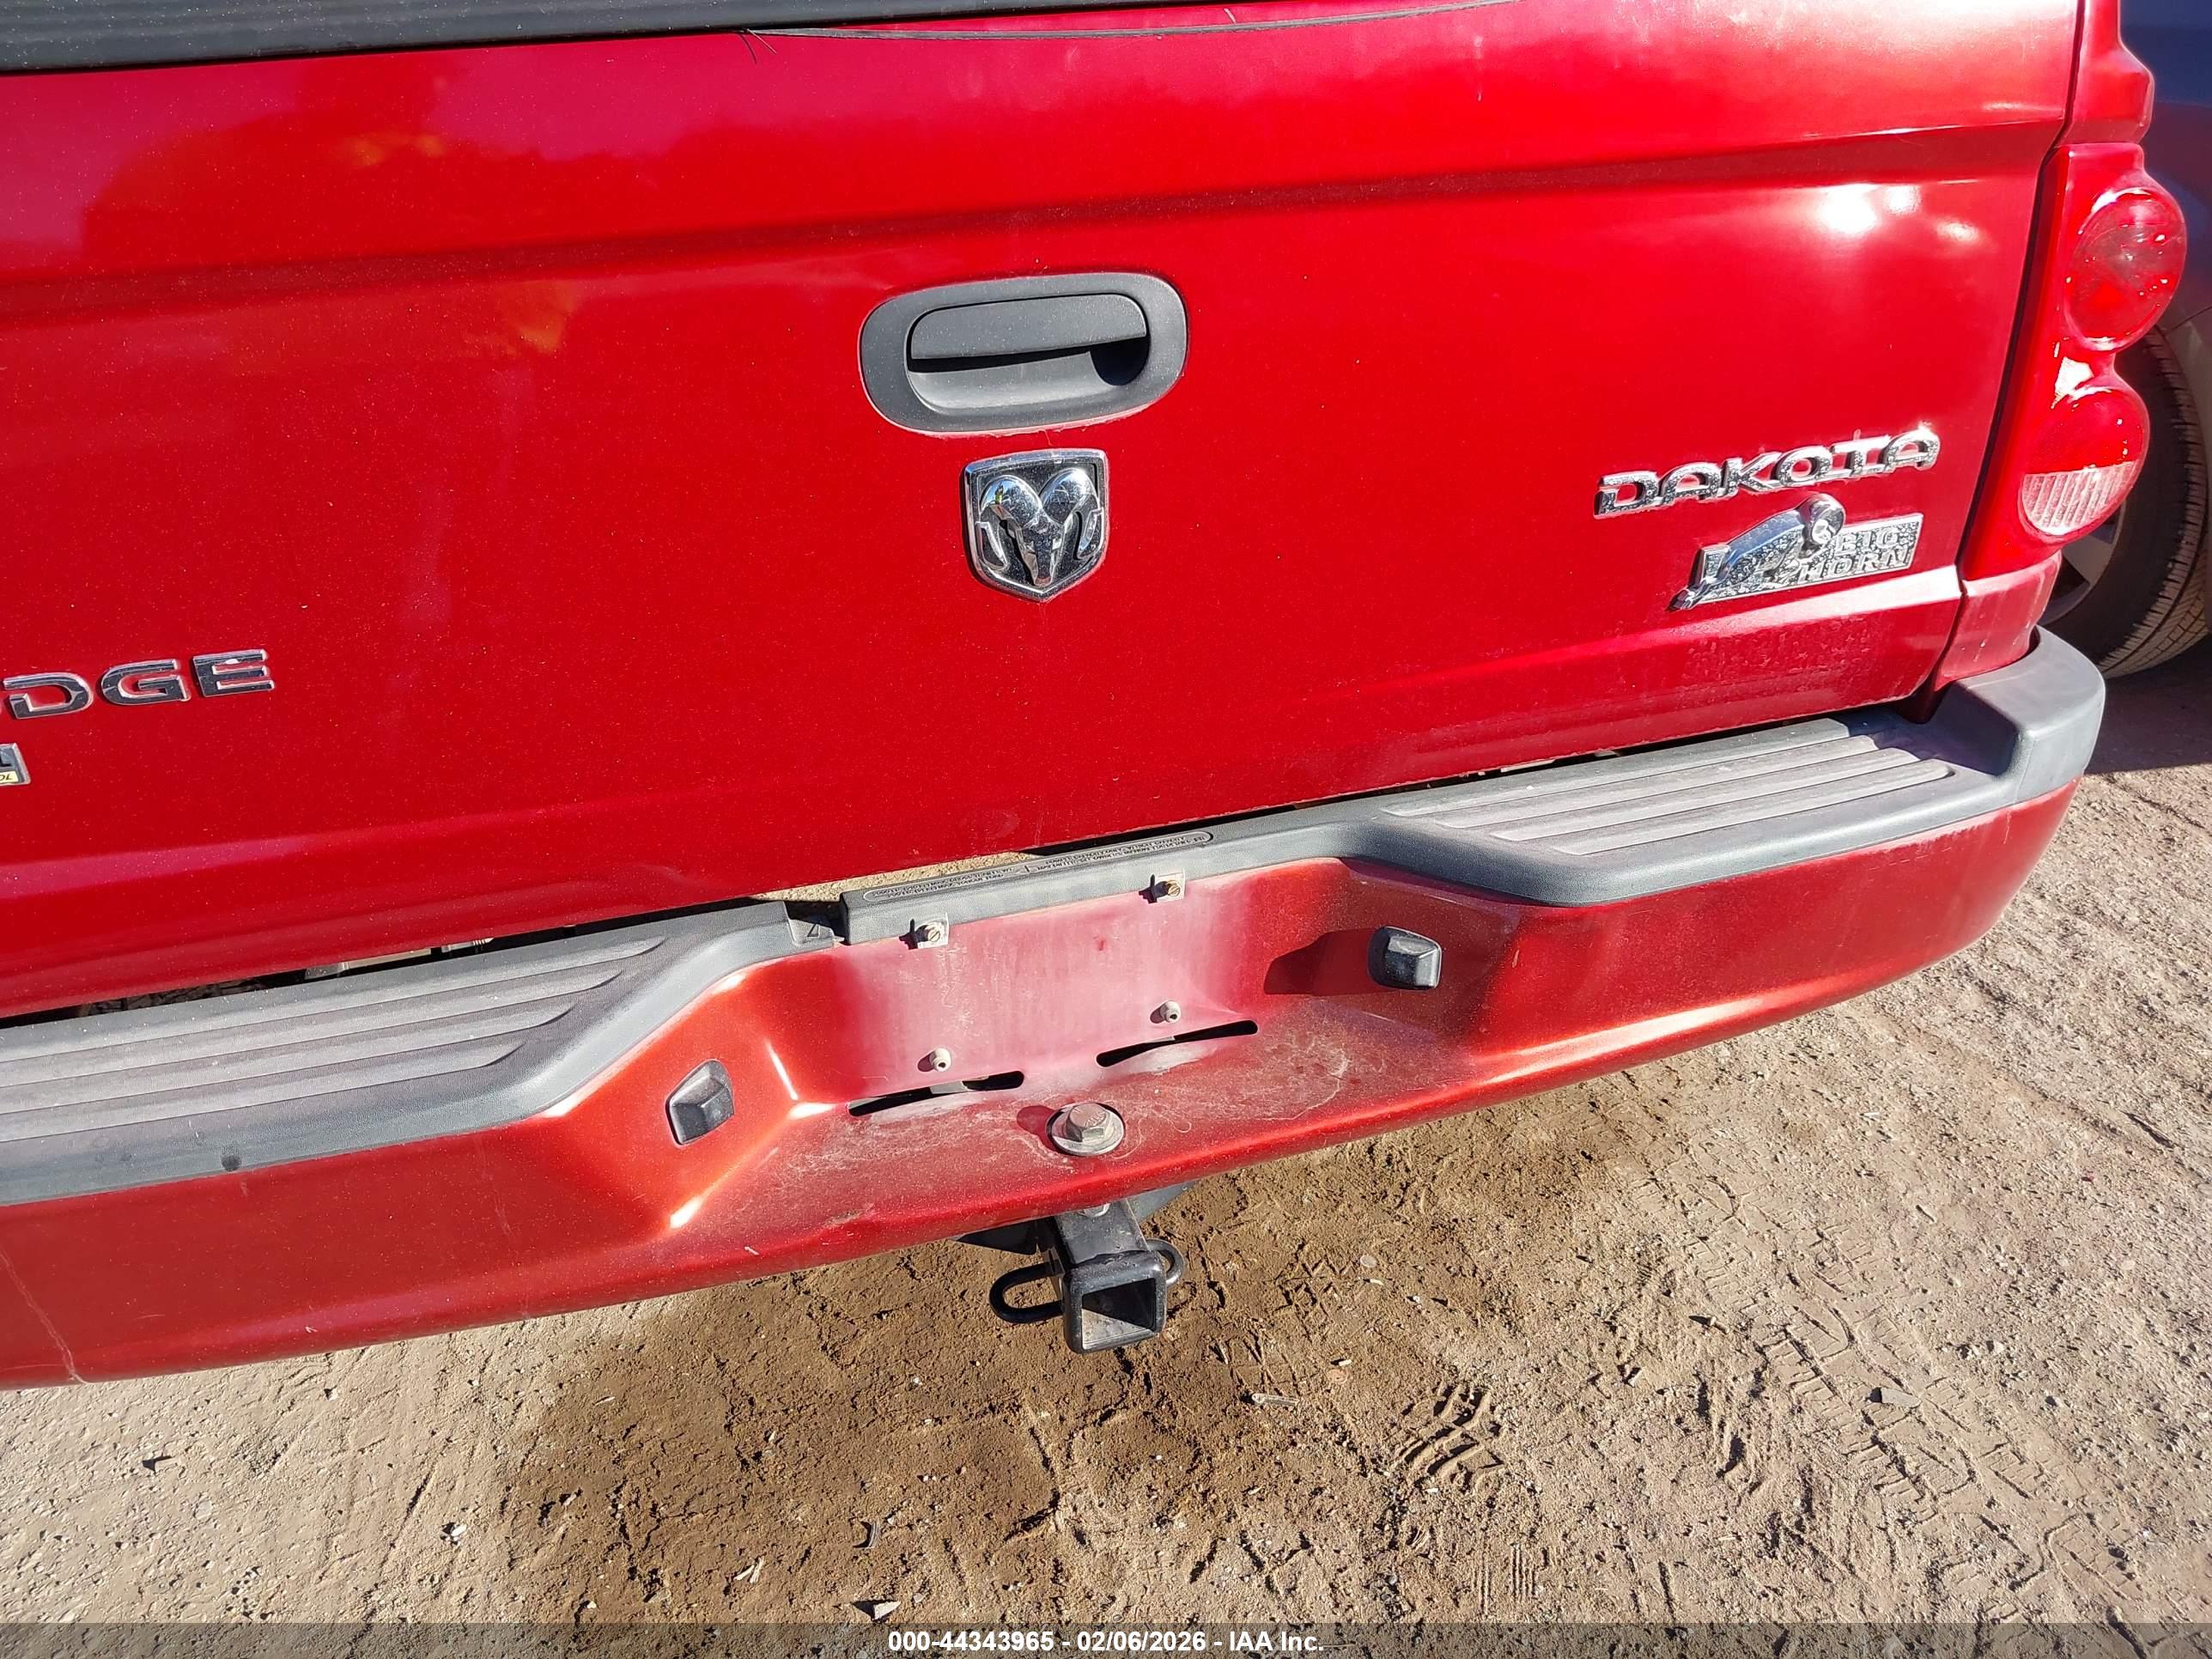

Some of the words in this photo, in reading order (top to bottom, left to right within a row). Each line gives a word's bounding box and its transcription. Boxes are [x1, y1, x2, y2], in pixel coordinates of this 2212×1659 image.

[1594, 428, 1940, 519] DAKOTA
[1833, 526, 1900, 556] BIG
[1796, 544, 1910, 585] HORN
